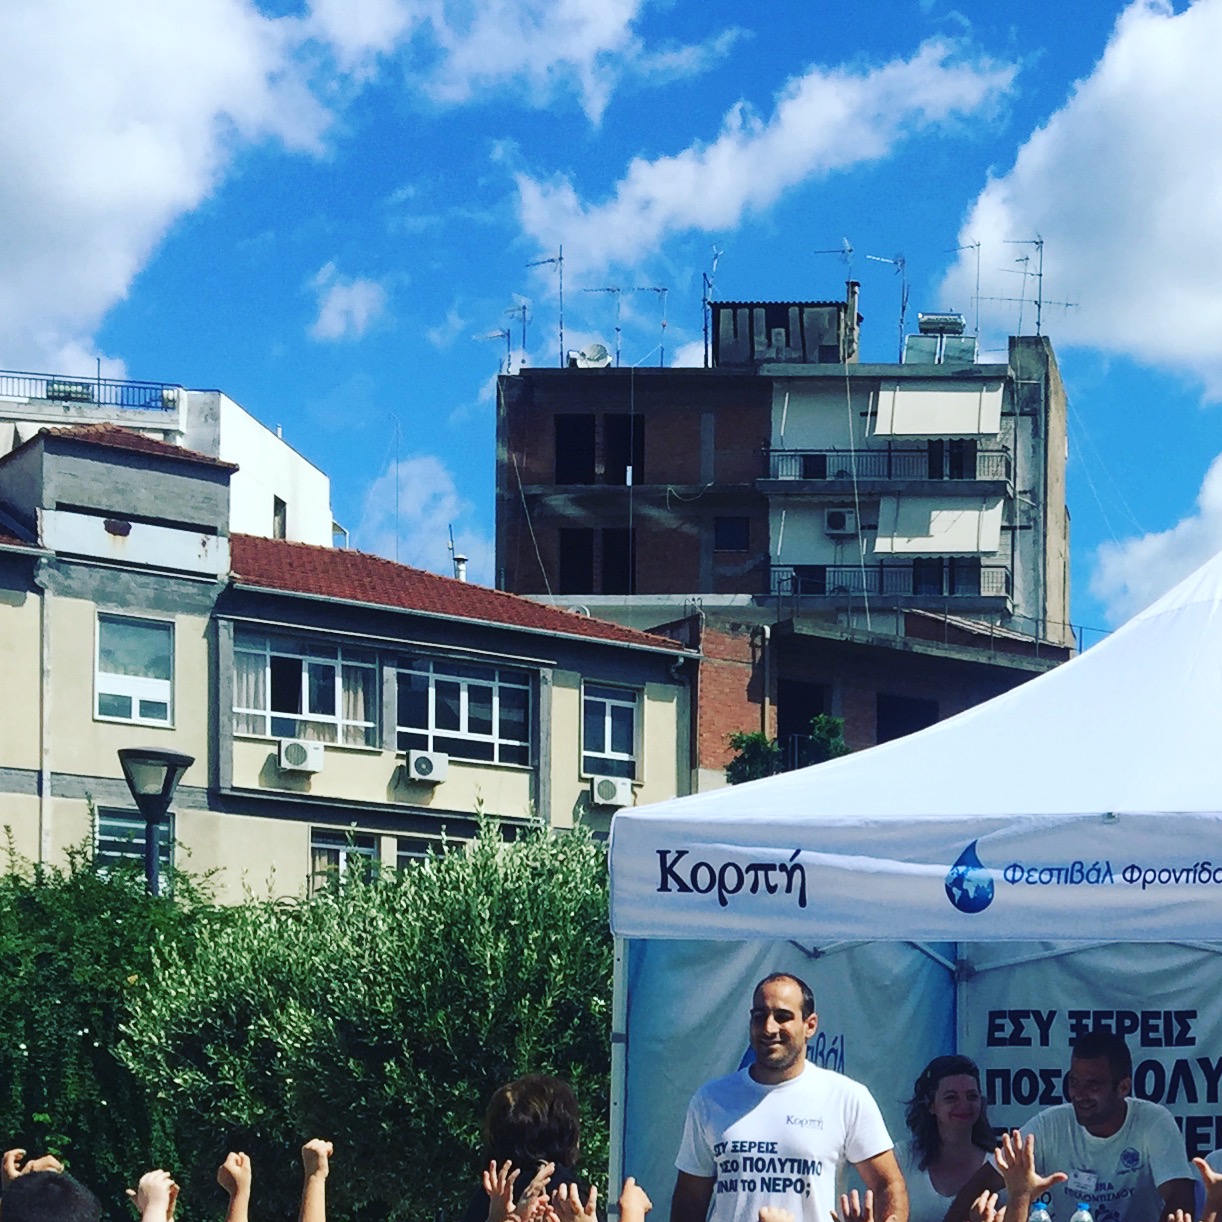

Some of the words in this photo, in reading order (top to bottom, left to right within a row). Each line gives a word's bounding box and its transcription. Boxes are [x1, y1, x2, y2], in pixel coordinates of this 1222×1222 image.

[656, 848, 807, 908] Κορπή
[1003, 860, 1114, 886] Φεστιβάλ
[987, 1010, 1057, 1047] ΕΣΥ
[986, 1068, 1070, 1106] ΠΟΣ
[731, 1141, 778, 1154] ΞΕΡΕΙΣ
[742, 1157, 822, 1176] ΠΟΛΥΤΙΜΟ
[741, 1180, 757, 1193] ΤΟ
[760, 1177, 811, 1198] ΝΕΡΟ;
